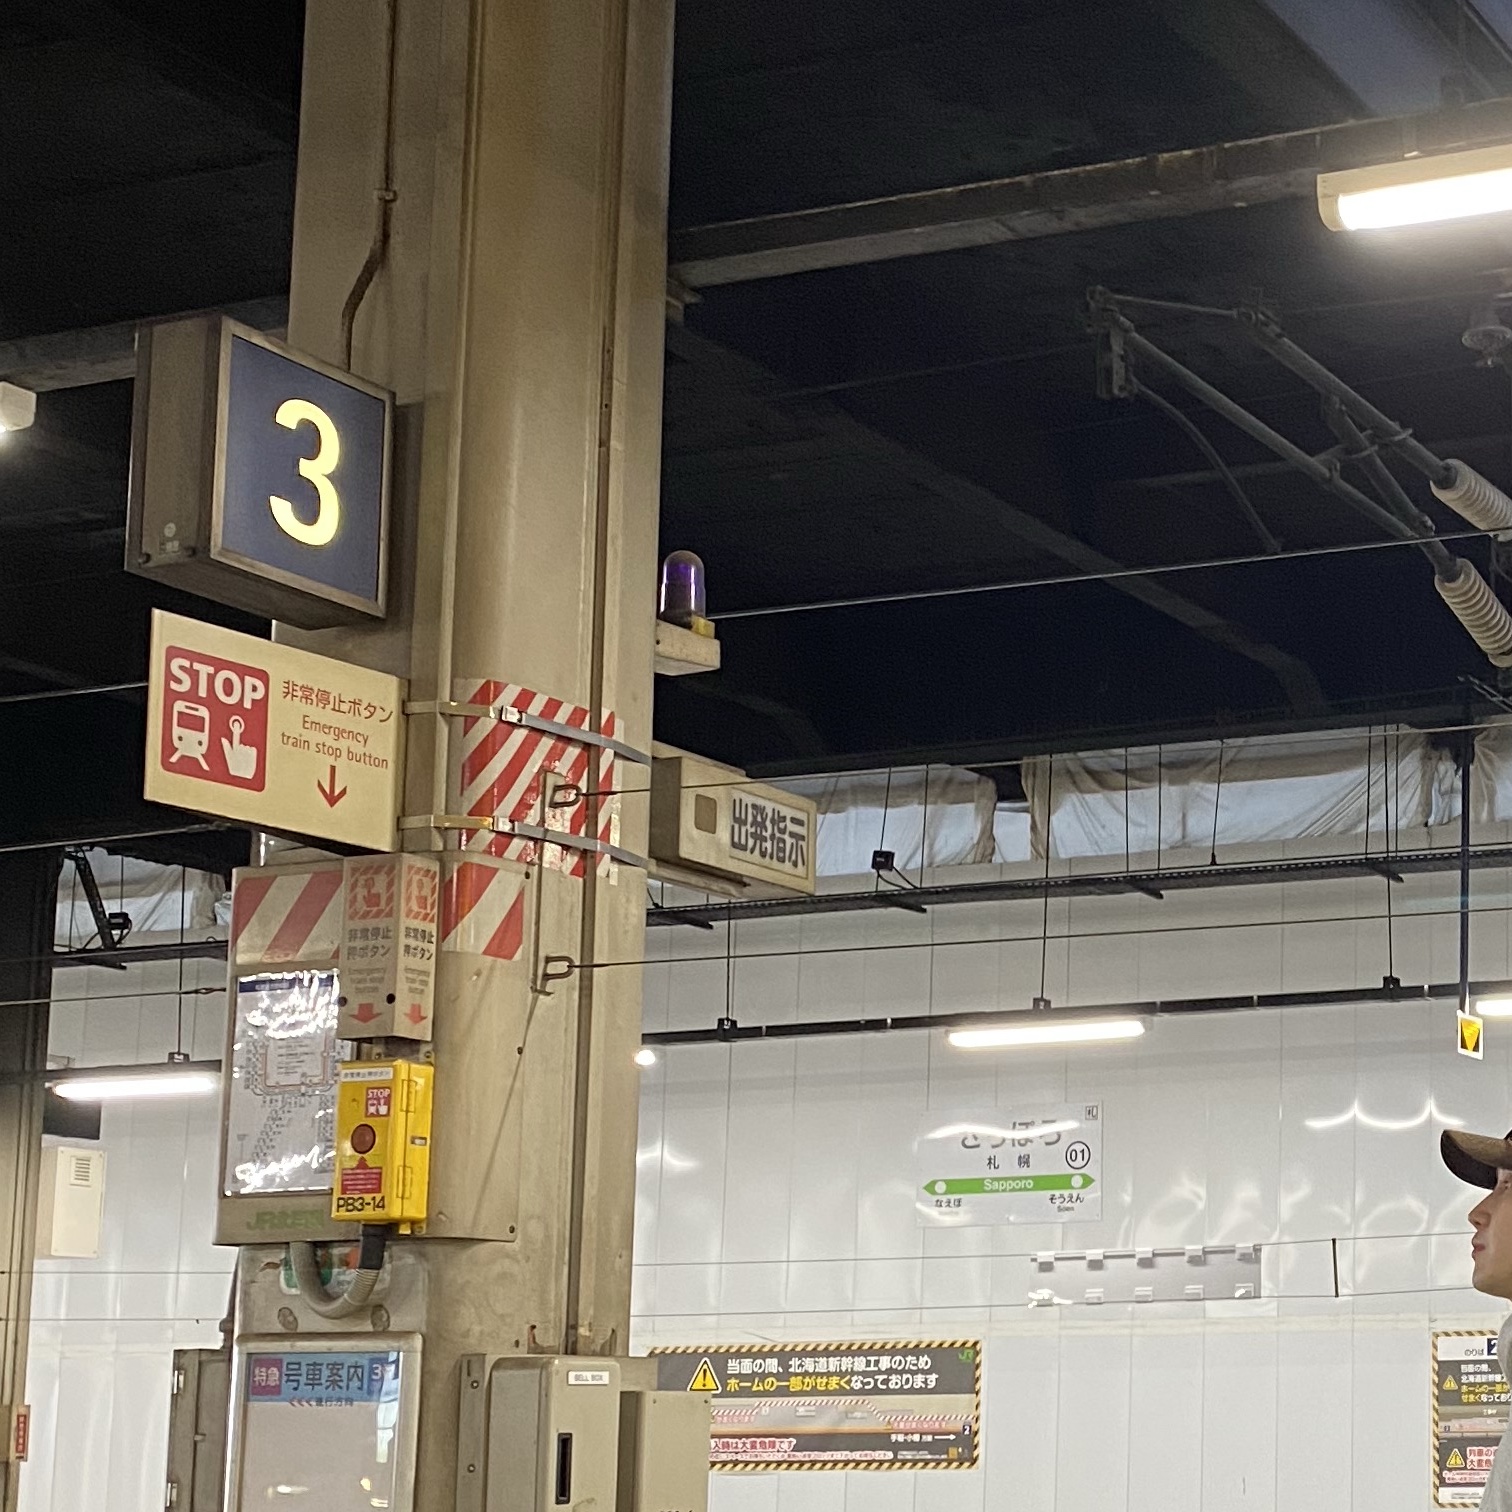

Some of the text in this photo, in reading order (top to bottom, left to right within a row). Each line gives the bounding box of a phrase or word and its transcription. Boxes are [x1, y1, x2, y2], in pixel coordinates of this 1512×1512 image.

[269, 398, 341, 547] 3
[169, 656, 266, 710] STOP
[281, 679, 394, 723] 非常停止ボタン
[302, 714, 369, 748] Emergency
[281, 731, 389, 770] train stop button
[730, 797, 806, 869] 出発指示
[367, 1088, 391, 1099] STOP
[986, 1153, 1031, 1170] 札幌
[1069, 1148, 1086, 1162] 01
[983, 1178, 1034, 1191] Sapporo
[336, 1195, 386, 1213] PB3-14
[934, 1198, 963, 1208] なえぼ
[1048, 1193, 1084, 1205] そうえん
[253, 1367, 280, 1387] 特急
[284, 1360, 365, 1393] 号車案内
[726, 1373, 939, 1393] ホームの一部がせまくなっております
